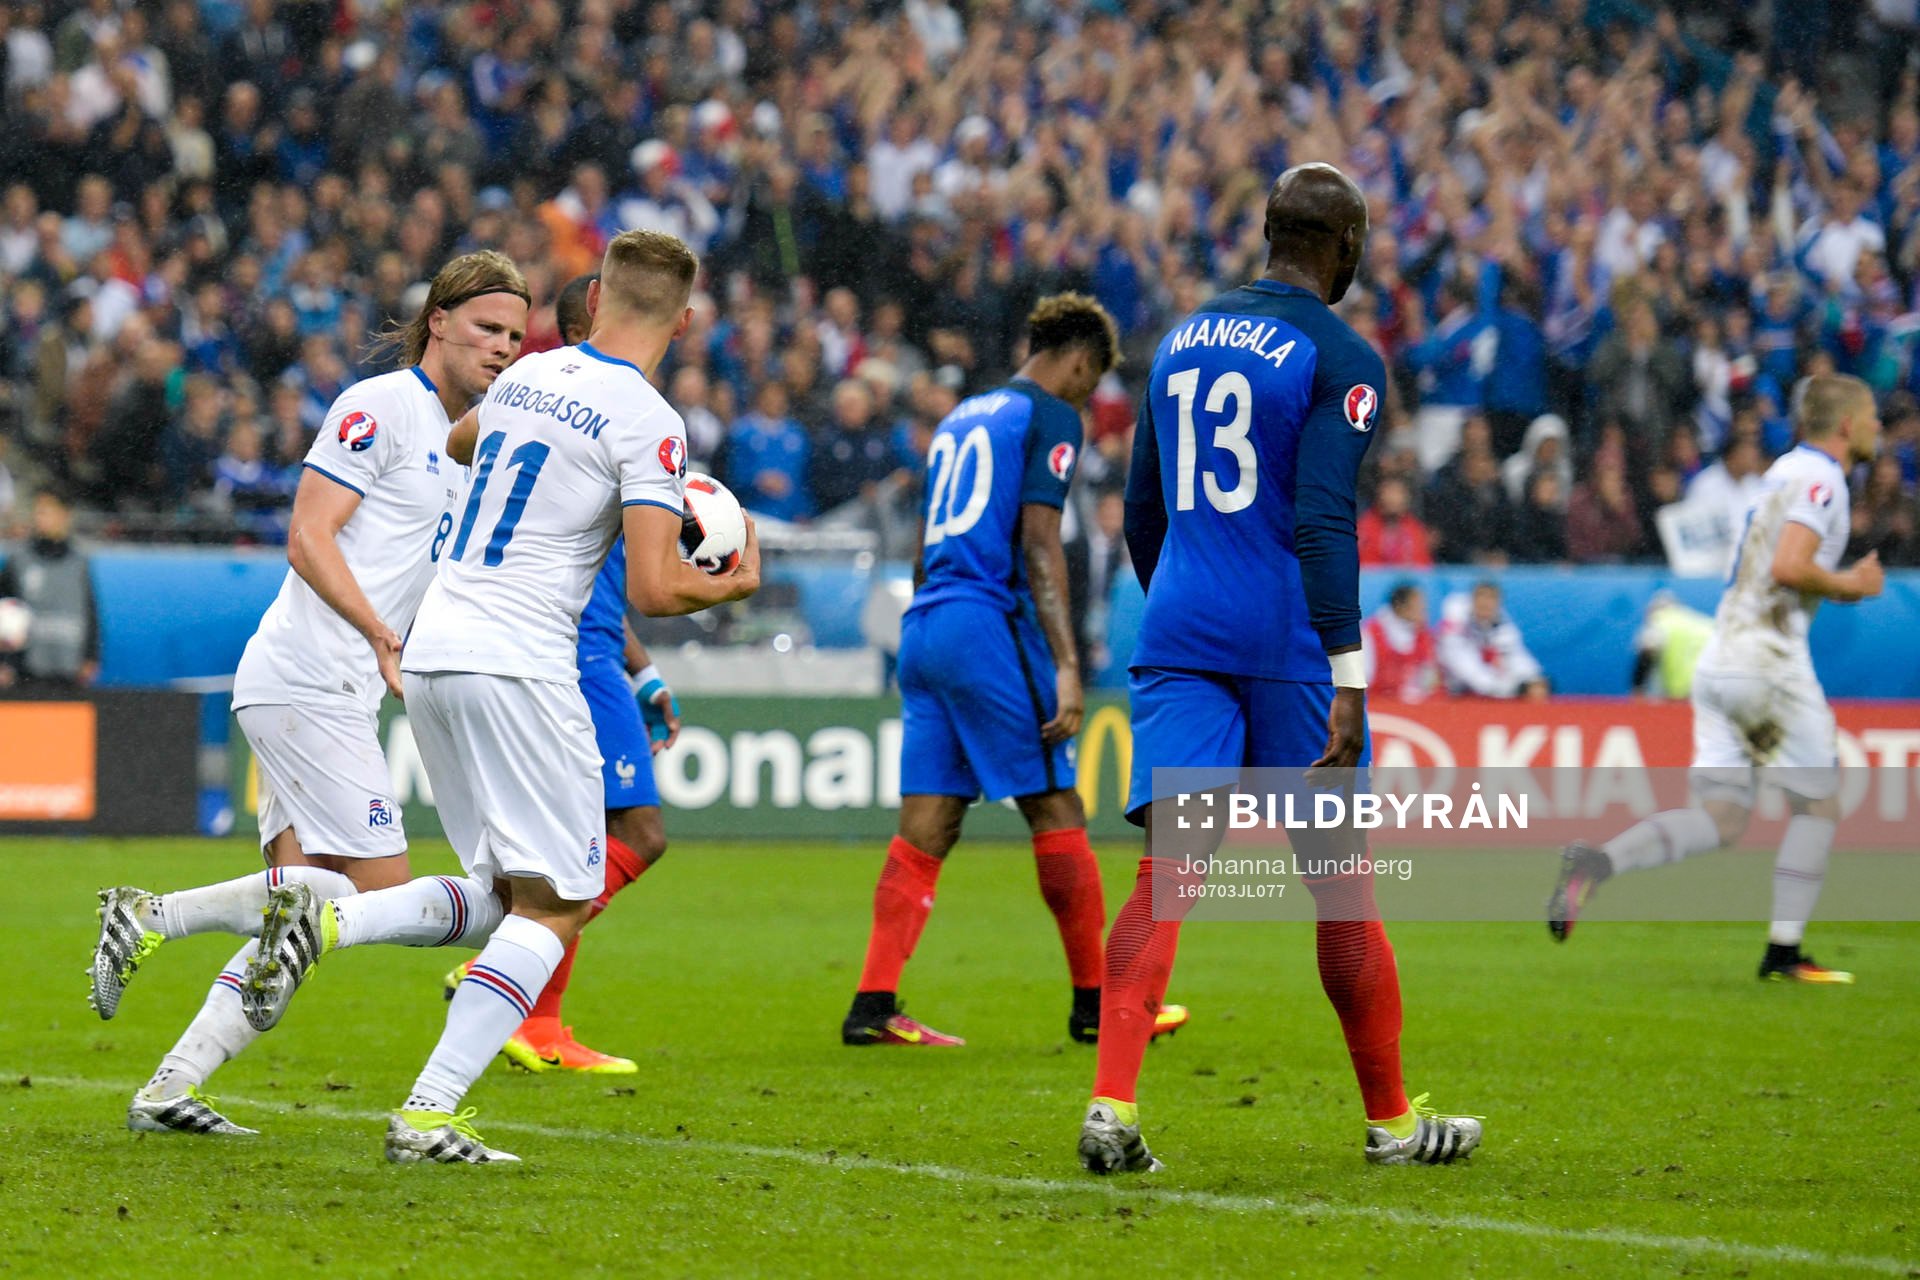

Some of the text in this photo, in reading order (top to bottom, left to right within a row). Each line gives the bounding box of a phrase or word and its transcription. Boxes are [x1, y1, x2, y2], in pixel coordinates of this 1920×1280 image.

[1170, 318, 1296, 368] MANGALA
[924, 425, 993, 546] 20
[1167, 367, 1258, 514] 13
[431, 511, 453, 563] 8
[448, 430, 551, 567] 11
[1478, 725, 1657, 820] KIA
